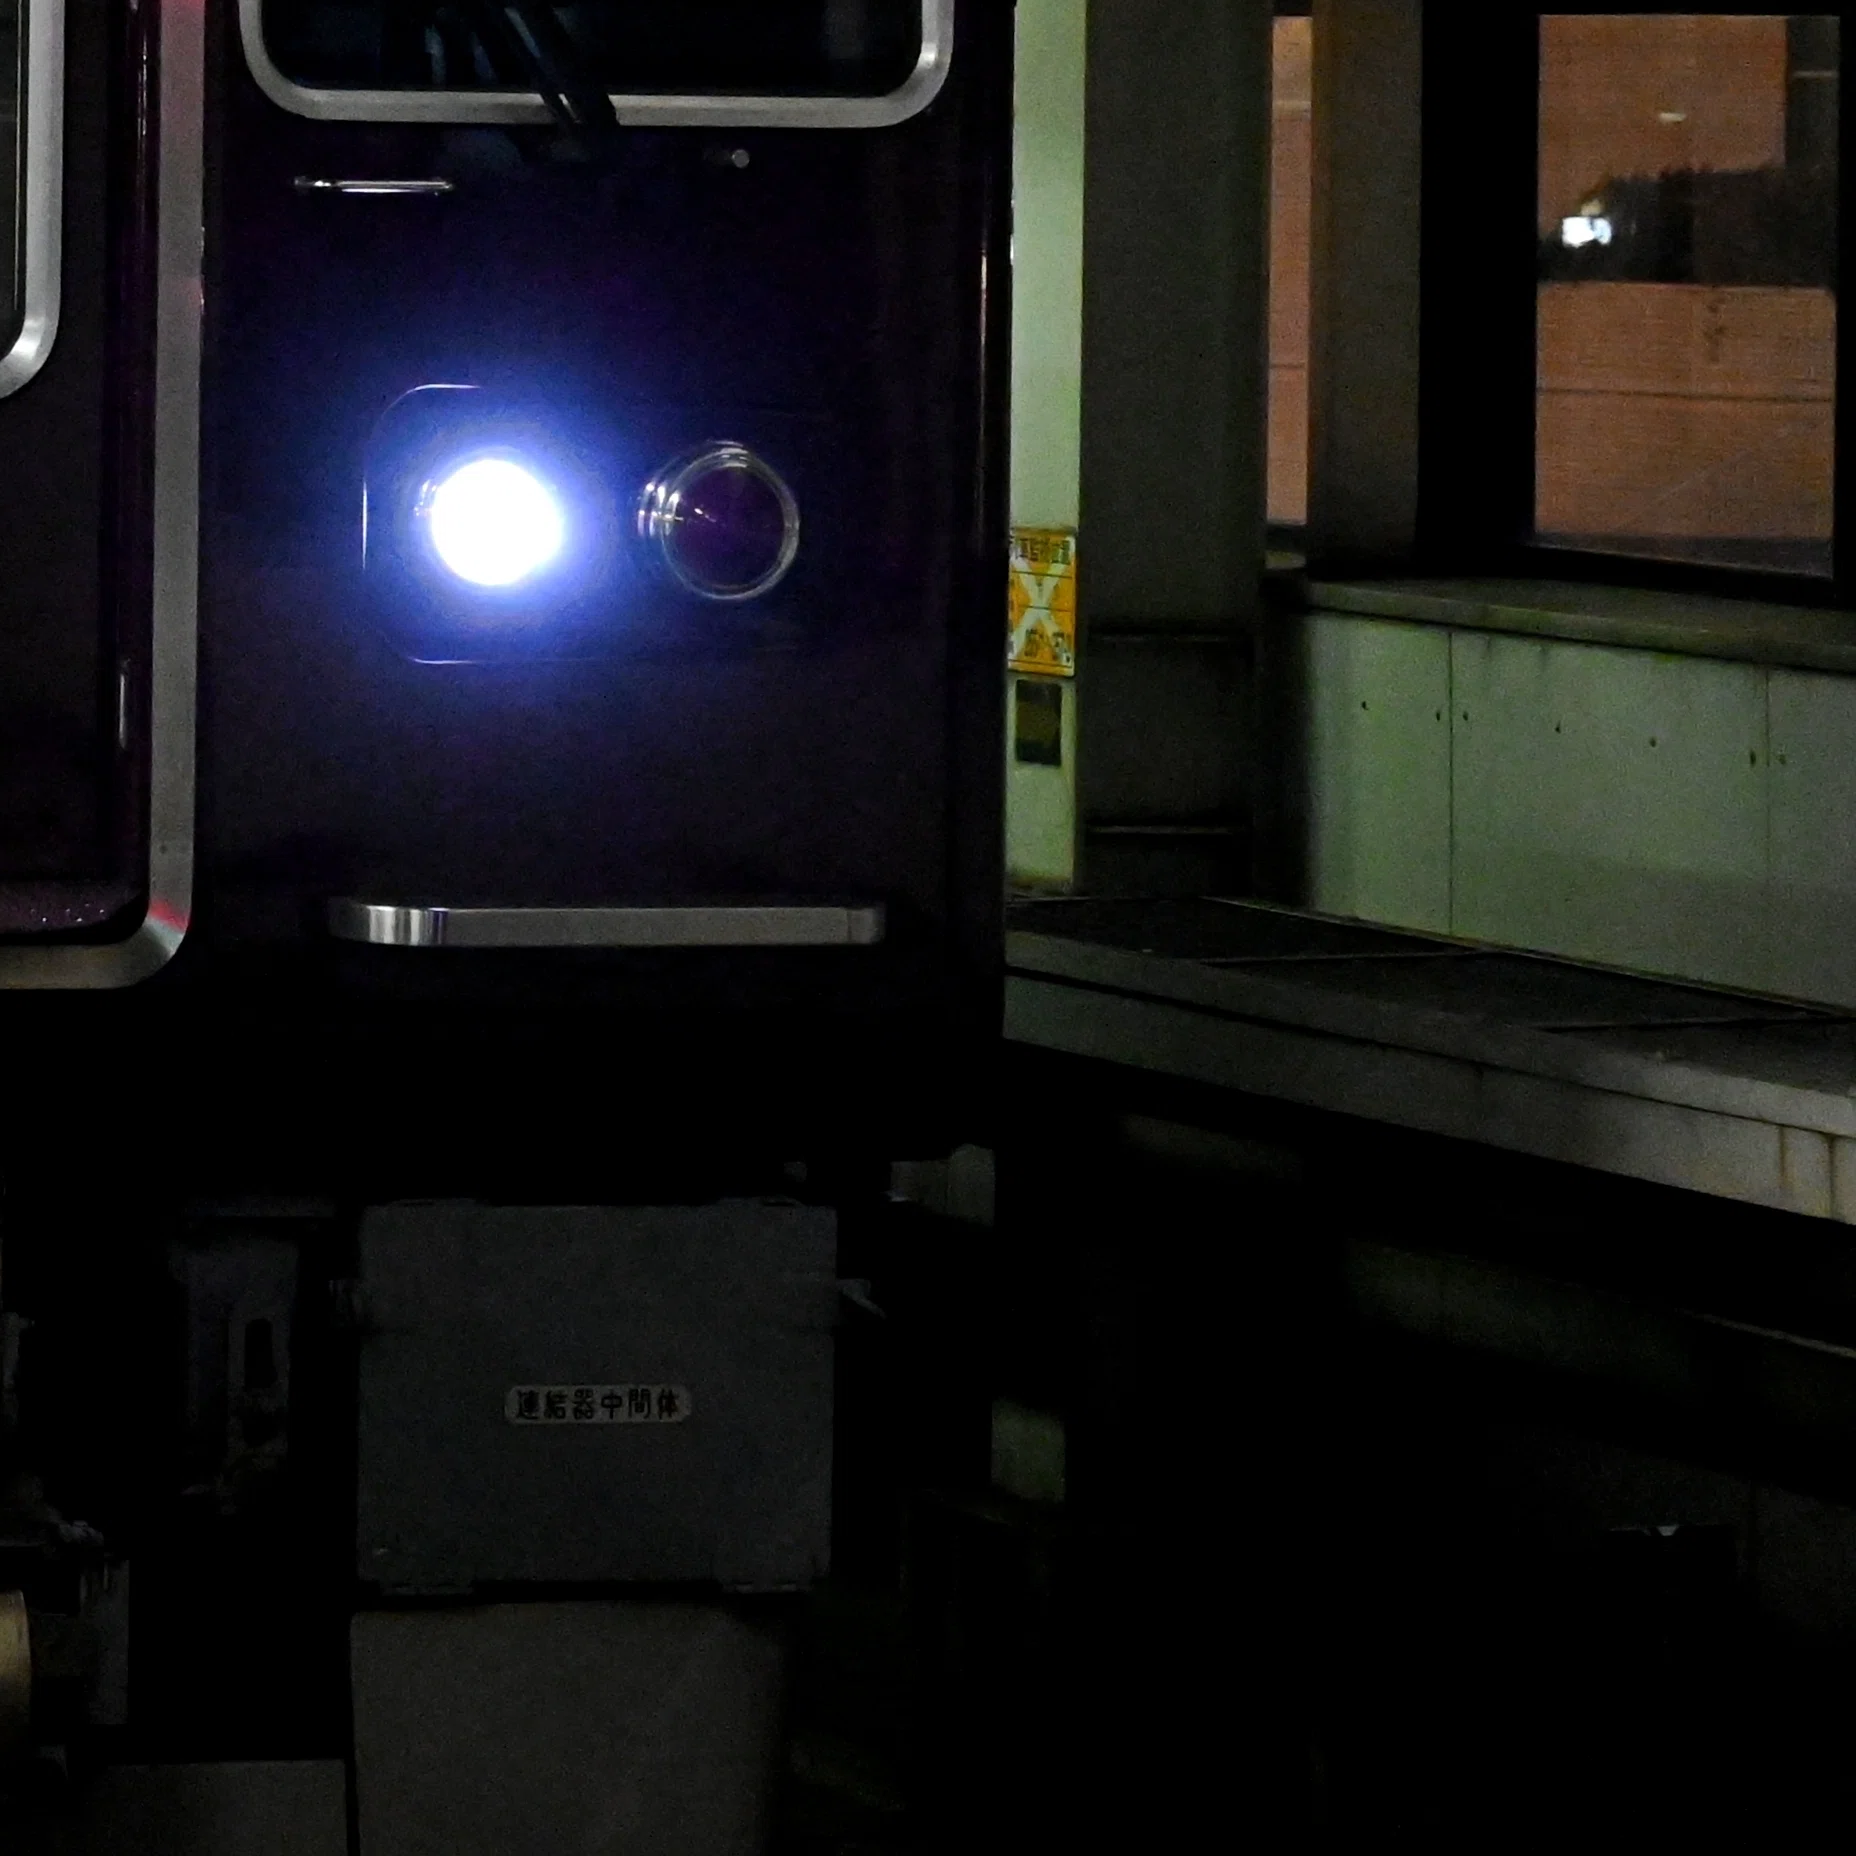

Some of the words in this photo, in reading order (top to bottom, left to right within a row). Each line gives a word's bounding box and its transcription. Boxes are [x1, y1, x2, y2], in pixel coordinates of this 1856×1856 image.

[517, 1388, 679, 1420] 連結器中間体
